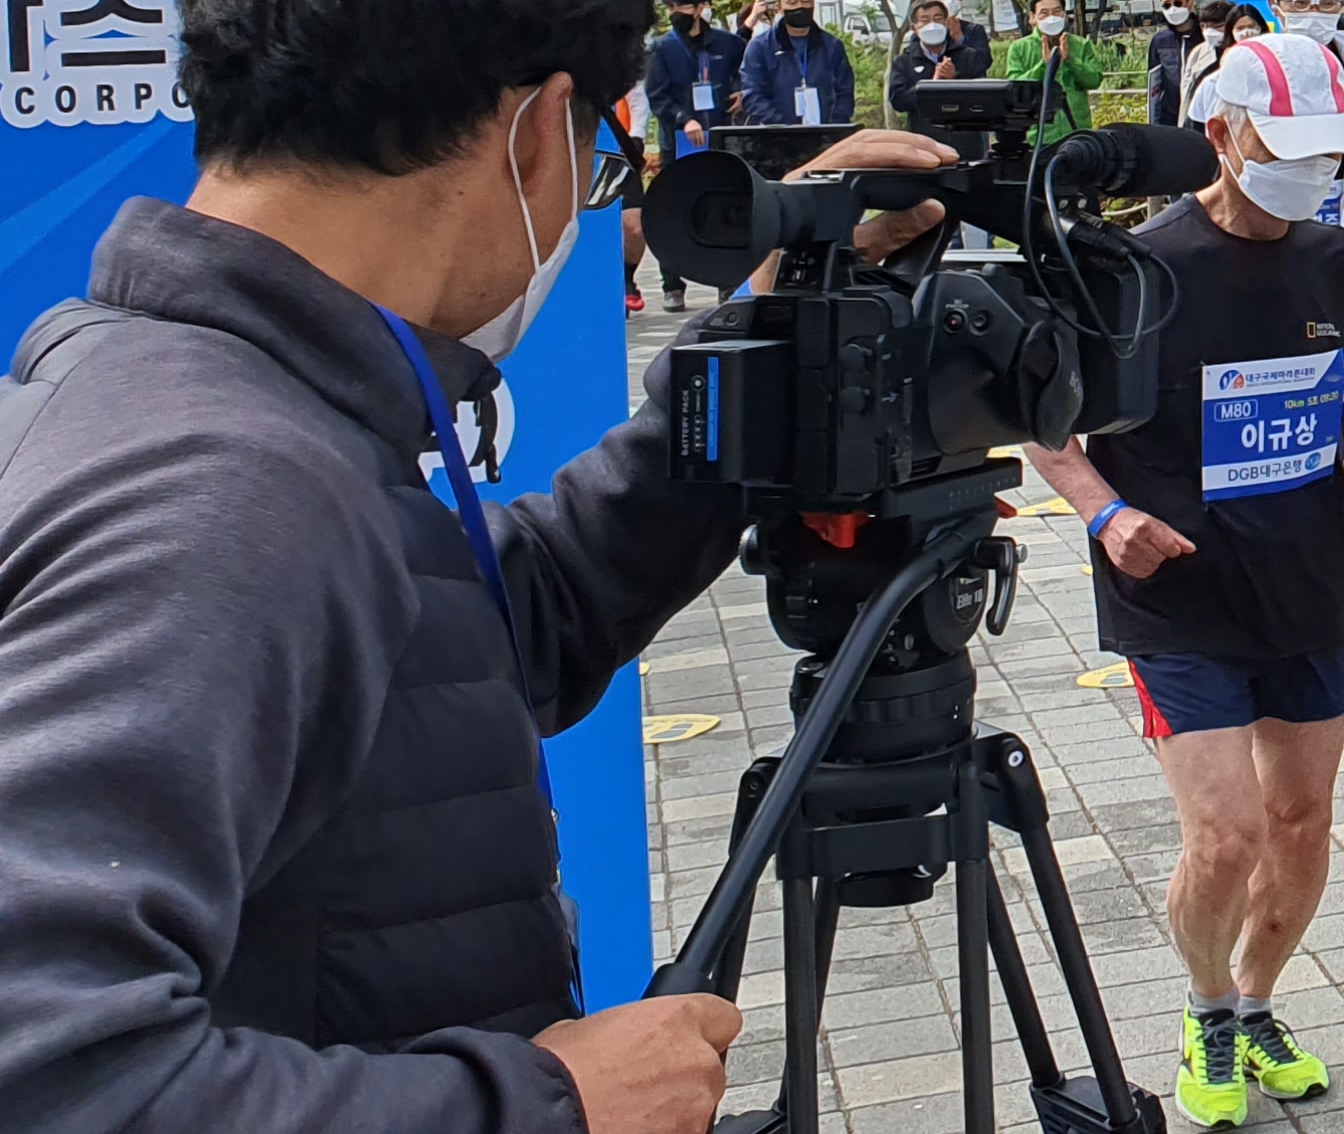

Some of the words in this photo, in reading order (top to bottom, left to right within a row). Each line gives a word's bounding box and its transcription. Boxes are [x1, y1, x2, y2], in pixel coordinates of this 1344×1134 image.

[1220, 403, 1252, 420] M80
[1240, 412, 1318, 454] 이규상
[1227, 459, 1303, 483] DGB대구은행
